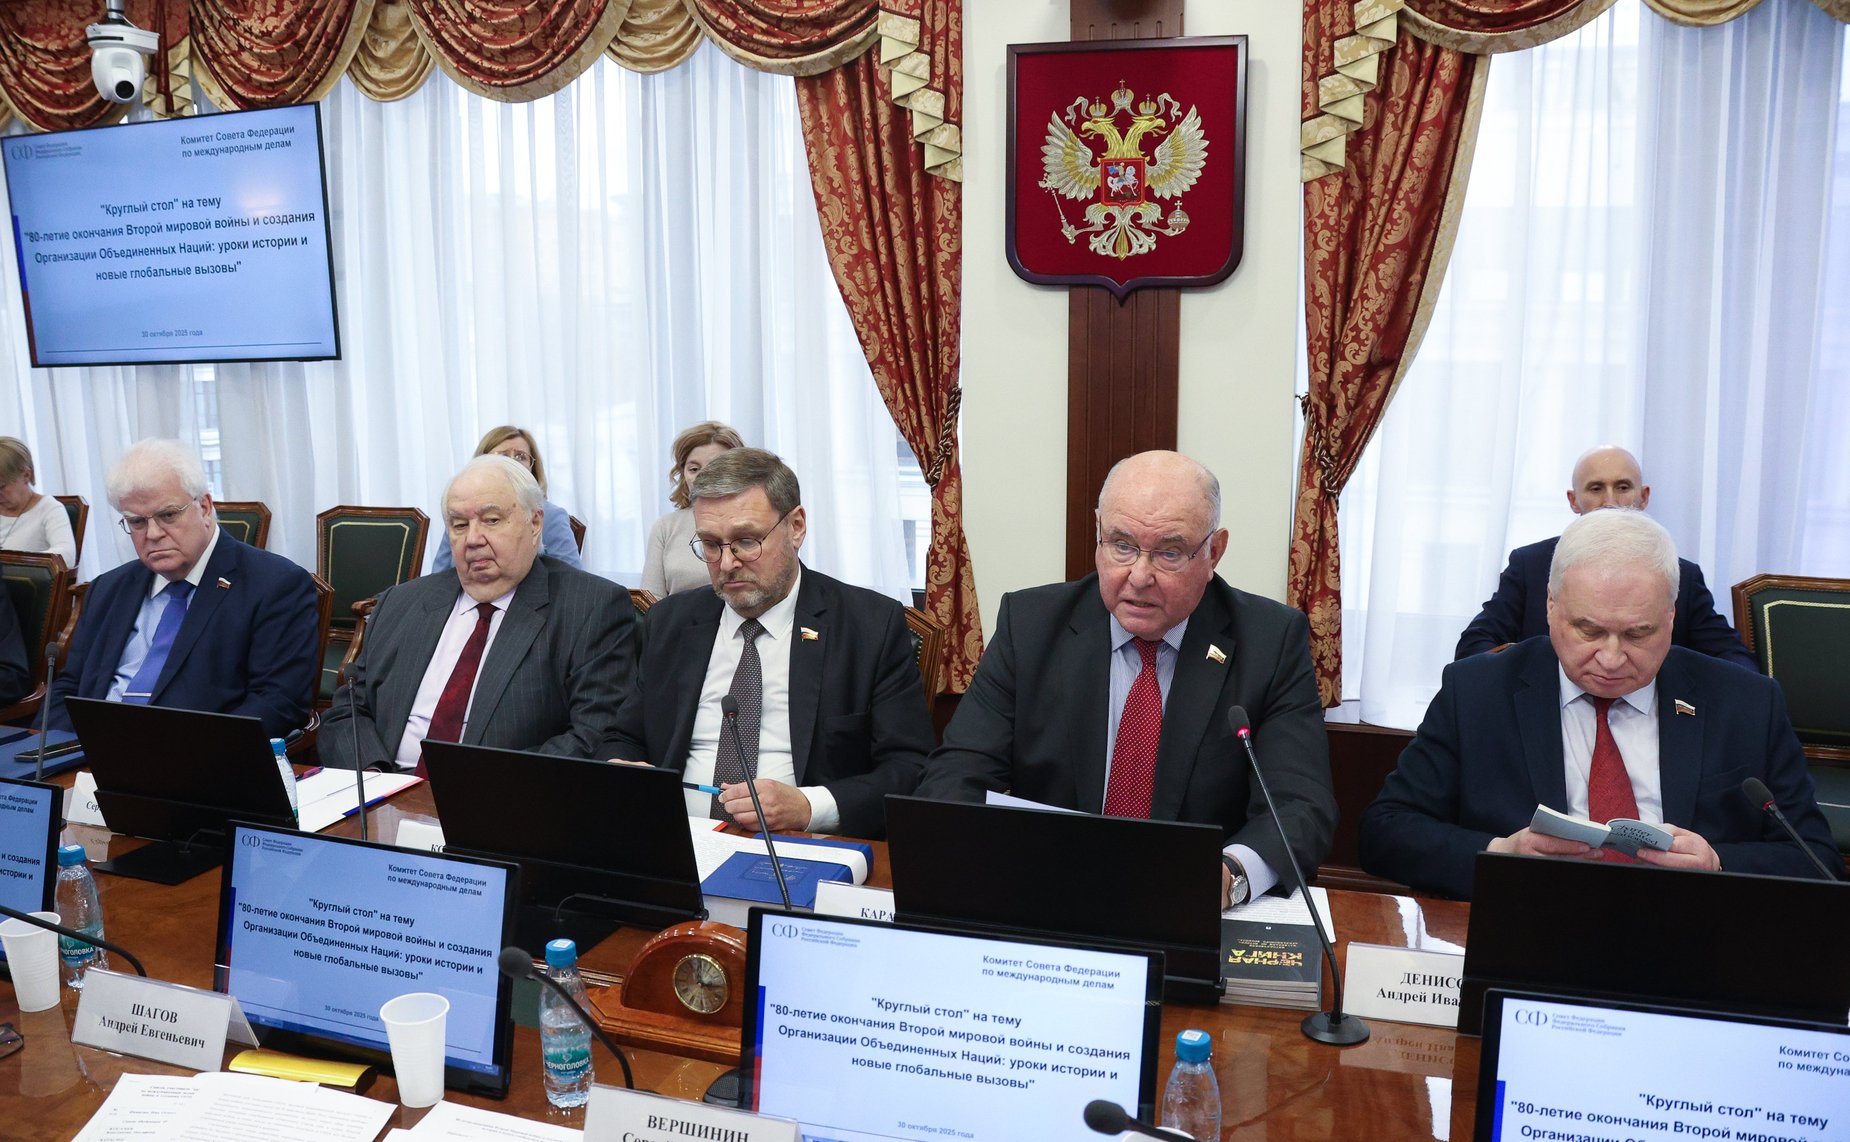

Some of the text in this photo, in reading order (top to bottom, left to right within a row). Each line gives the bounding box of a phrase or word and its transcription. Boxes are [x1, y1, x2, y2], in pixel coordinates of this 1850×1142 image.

[180, 126, 295, 145] Комитет Совета Федерации
[182, 140, 292, 158] по международным делам
[100, 197, 221, 217] "Круглый стол" на тему
[72, 227, 124, 240] окончания
[126, 222, 163, 237] Второй
[166, 218, 212, 234] мировой
[215, 216, 250, 228] войны
[253, 216, 260, 226] и
[262, 212, 315, 226] создания
[35, 236, 308, 265] Организации Объединенных Наций: уроки истории и
[96, 261, 242, 281] новые глобальные вызовы"
[86, 800, 101, 813] Сер
[241, 834, 260, 848] СФ
[7, 854, 40, 866] создания
[388, 864, 487, 887] Комитет Совета Федерации
[398, 877, 458, 892] международным
[459, 887, 482, 896] делам
[309, 898, 415, 928] "Круглый стол" на тему
[860, 907, 895, 922] КАРА
[238, 902, 493, 958] "80-летие окончания Второй мировой войны и создания
[771, 923, 799, 939] СФ
[243, 920, 483, 975] Организации Объединенных Наций: уроки истории и
[293, 948, 423, 981] новые глобальные вызовы"
[982, 955, 1121, 978] Комитет Совета Федерации
[982, 968, 1115, 990] по международным делам
[1376, 987, 1460, 1008] Андрей Ива
[131, 1003, 178, 1024] ШАГОВ
[871, 997, 1022, 1029] "Круглый стол" на тему
[1515, 1008, 1548, 1026] СФ
[98, 1015, 206, 1049] Андрей Евгеньевич
[770, 1003, 1130, 1061] "80-летие окончания Второй мировой войны и создания
[778, 1024, 1118, 1080] Организации Объединенных Наций: уроки истории и
[1779, 1045, 1830, 1060] Комитет
[851, 1056, 1036, 1090] новые глобальные вызовы"
[1778, 1061, 1793, 1070] по
[1511, 1100, 1582, 1121] "80-летие
[1587, 1112, 1669, 1132] окончания
[1673, 1120, 1731, 1140] Второй
[1639, 1093, 1829, 1131] "Круглый стол" на тему
[647, 1114, 749, 1142] ВЕРШИНИН
[907, 1123, 937, 1133] октября
[939, 1127, 956, 1136] 2025
[957, 1131, 975, 1139] года
